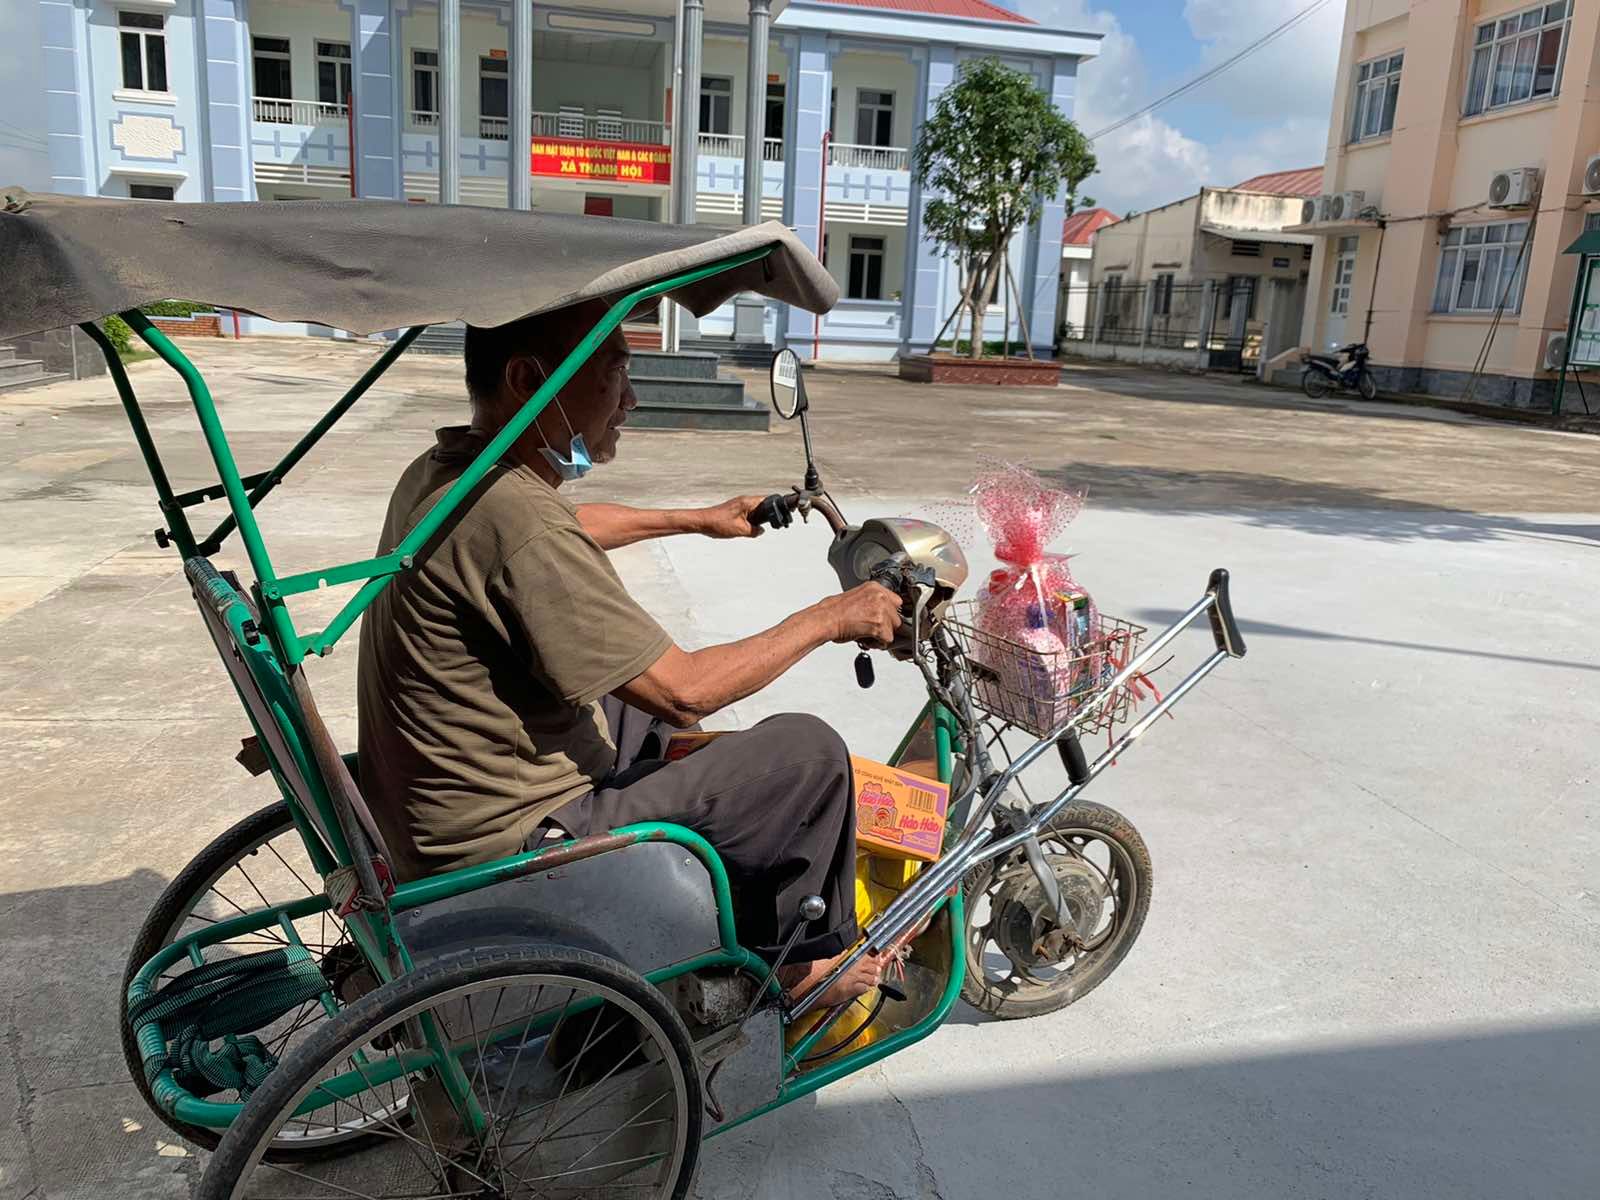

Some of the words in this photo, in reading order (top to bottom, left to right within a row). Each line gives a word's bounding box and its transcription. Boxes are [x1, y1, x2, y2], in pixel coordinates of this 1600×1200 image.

[545, 143, 558, 157] MẶT
[559, 144, 575, 158] TRẬN
[585, 144, 602, 158] QUỐC
[603, 146, 616, 160] VIỆT
[617, 150, 631, 161] NAM
[560, 159, 577, 172] XÃ
[578, 161, 617, 176] THẠNH
[621, 163, 642, 179] HỘI
[900, 814, 919, 830] Hảo
[919, 817, 940, 832] Hảo
